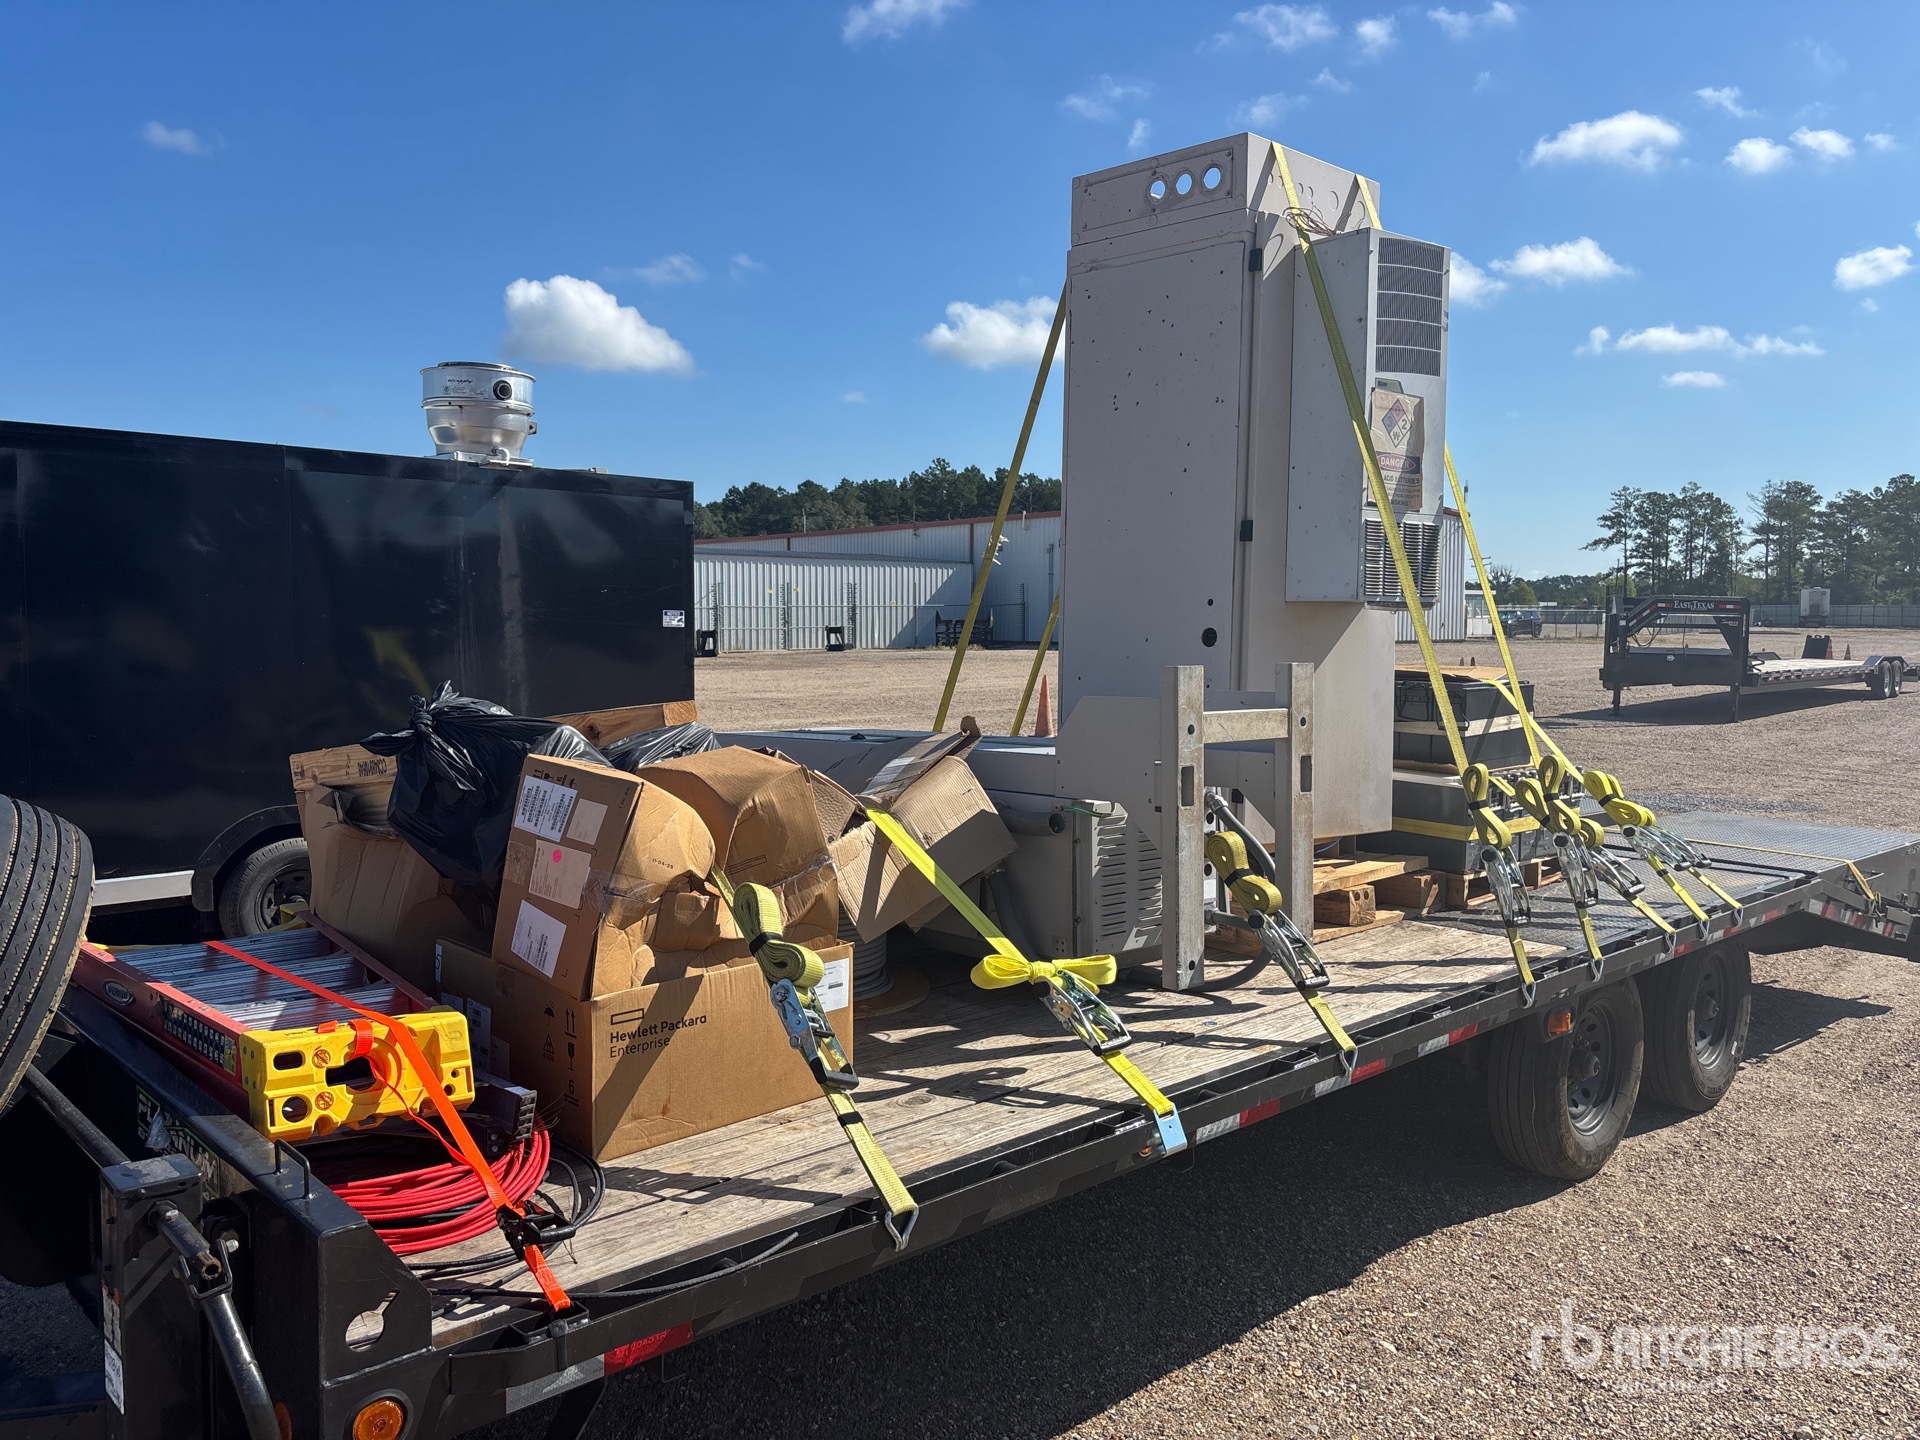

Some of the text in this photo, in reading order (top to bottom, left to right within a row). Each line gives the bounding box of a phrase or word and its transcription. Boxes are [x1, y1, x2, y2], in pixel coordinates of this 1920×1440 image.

[1401, 418, 1408, 430] 2
[1380, 456, 1411, 469] DANGER
[1673, 600, 1691, 609] EAST
[1691, 600, 1715, 609] TEXAS
[610, 1023, 658, 1044] Hewlett
[609, 1037, 670, 1058] Enterprise
